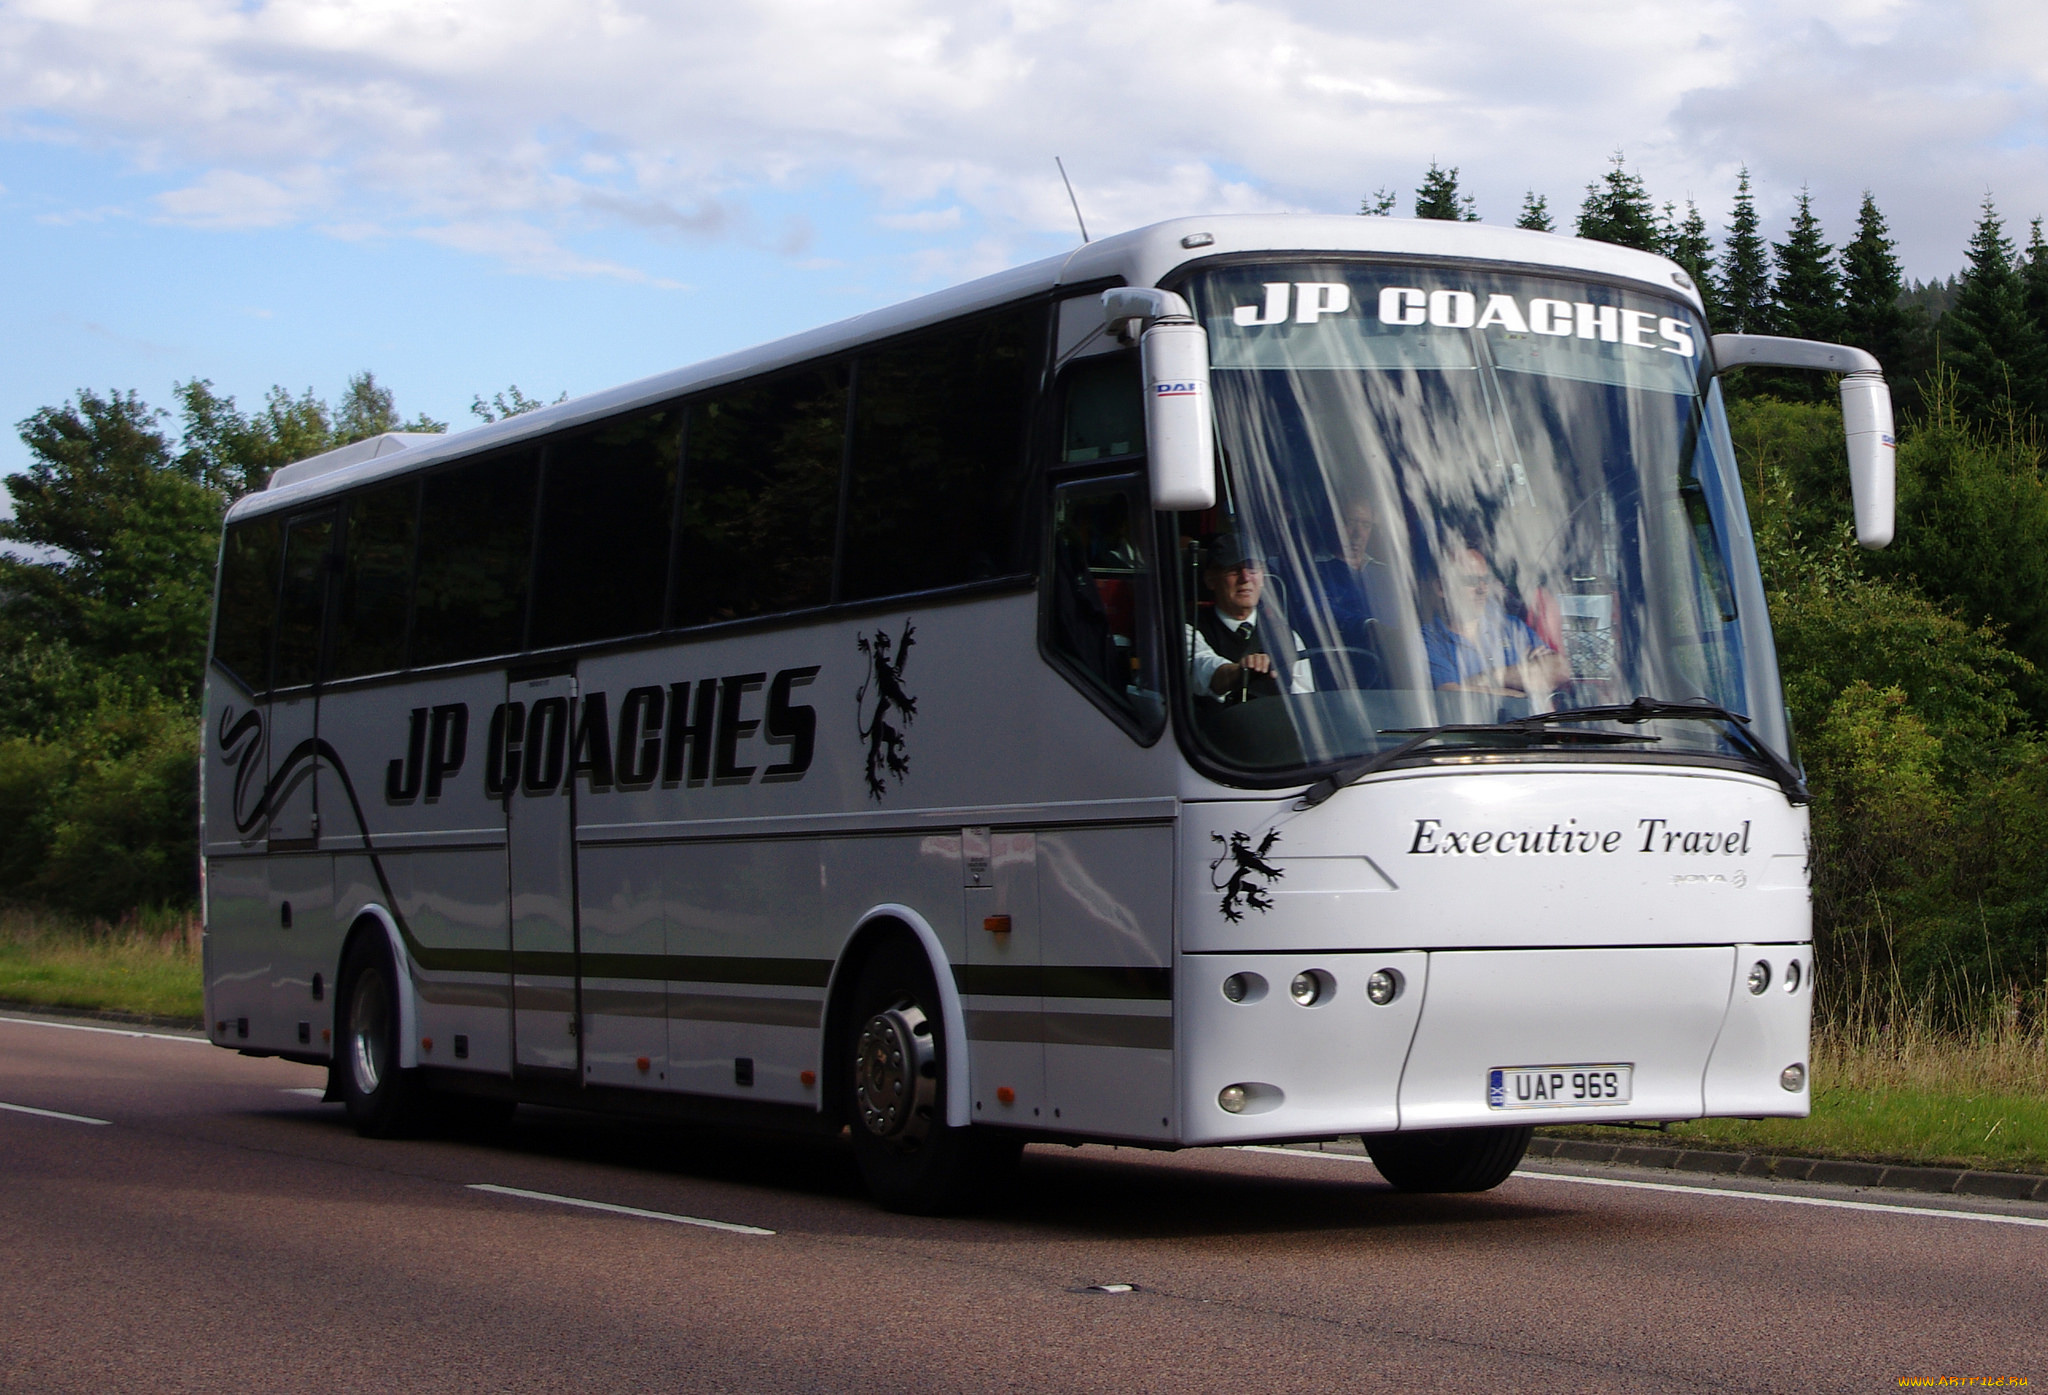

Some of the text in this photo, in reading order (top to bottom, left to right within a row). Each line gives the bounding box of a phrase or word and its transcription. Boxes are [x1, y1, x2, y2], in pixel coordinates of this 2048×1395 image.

[1233, 282, 1695, 358] JP COACHES
[385, 665, 822, 806] JP COACHES
[1408, 818, 1752, 855] Executive Travel
[1516, 1072, 1618, 1101] UAP 969
